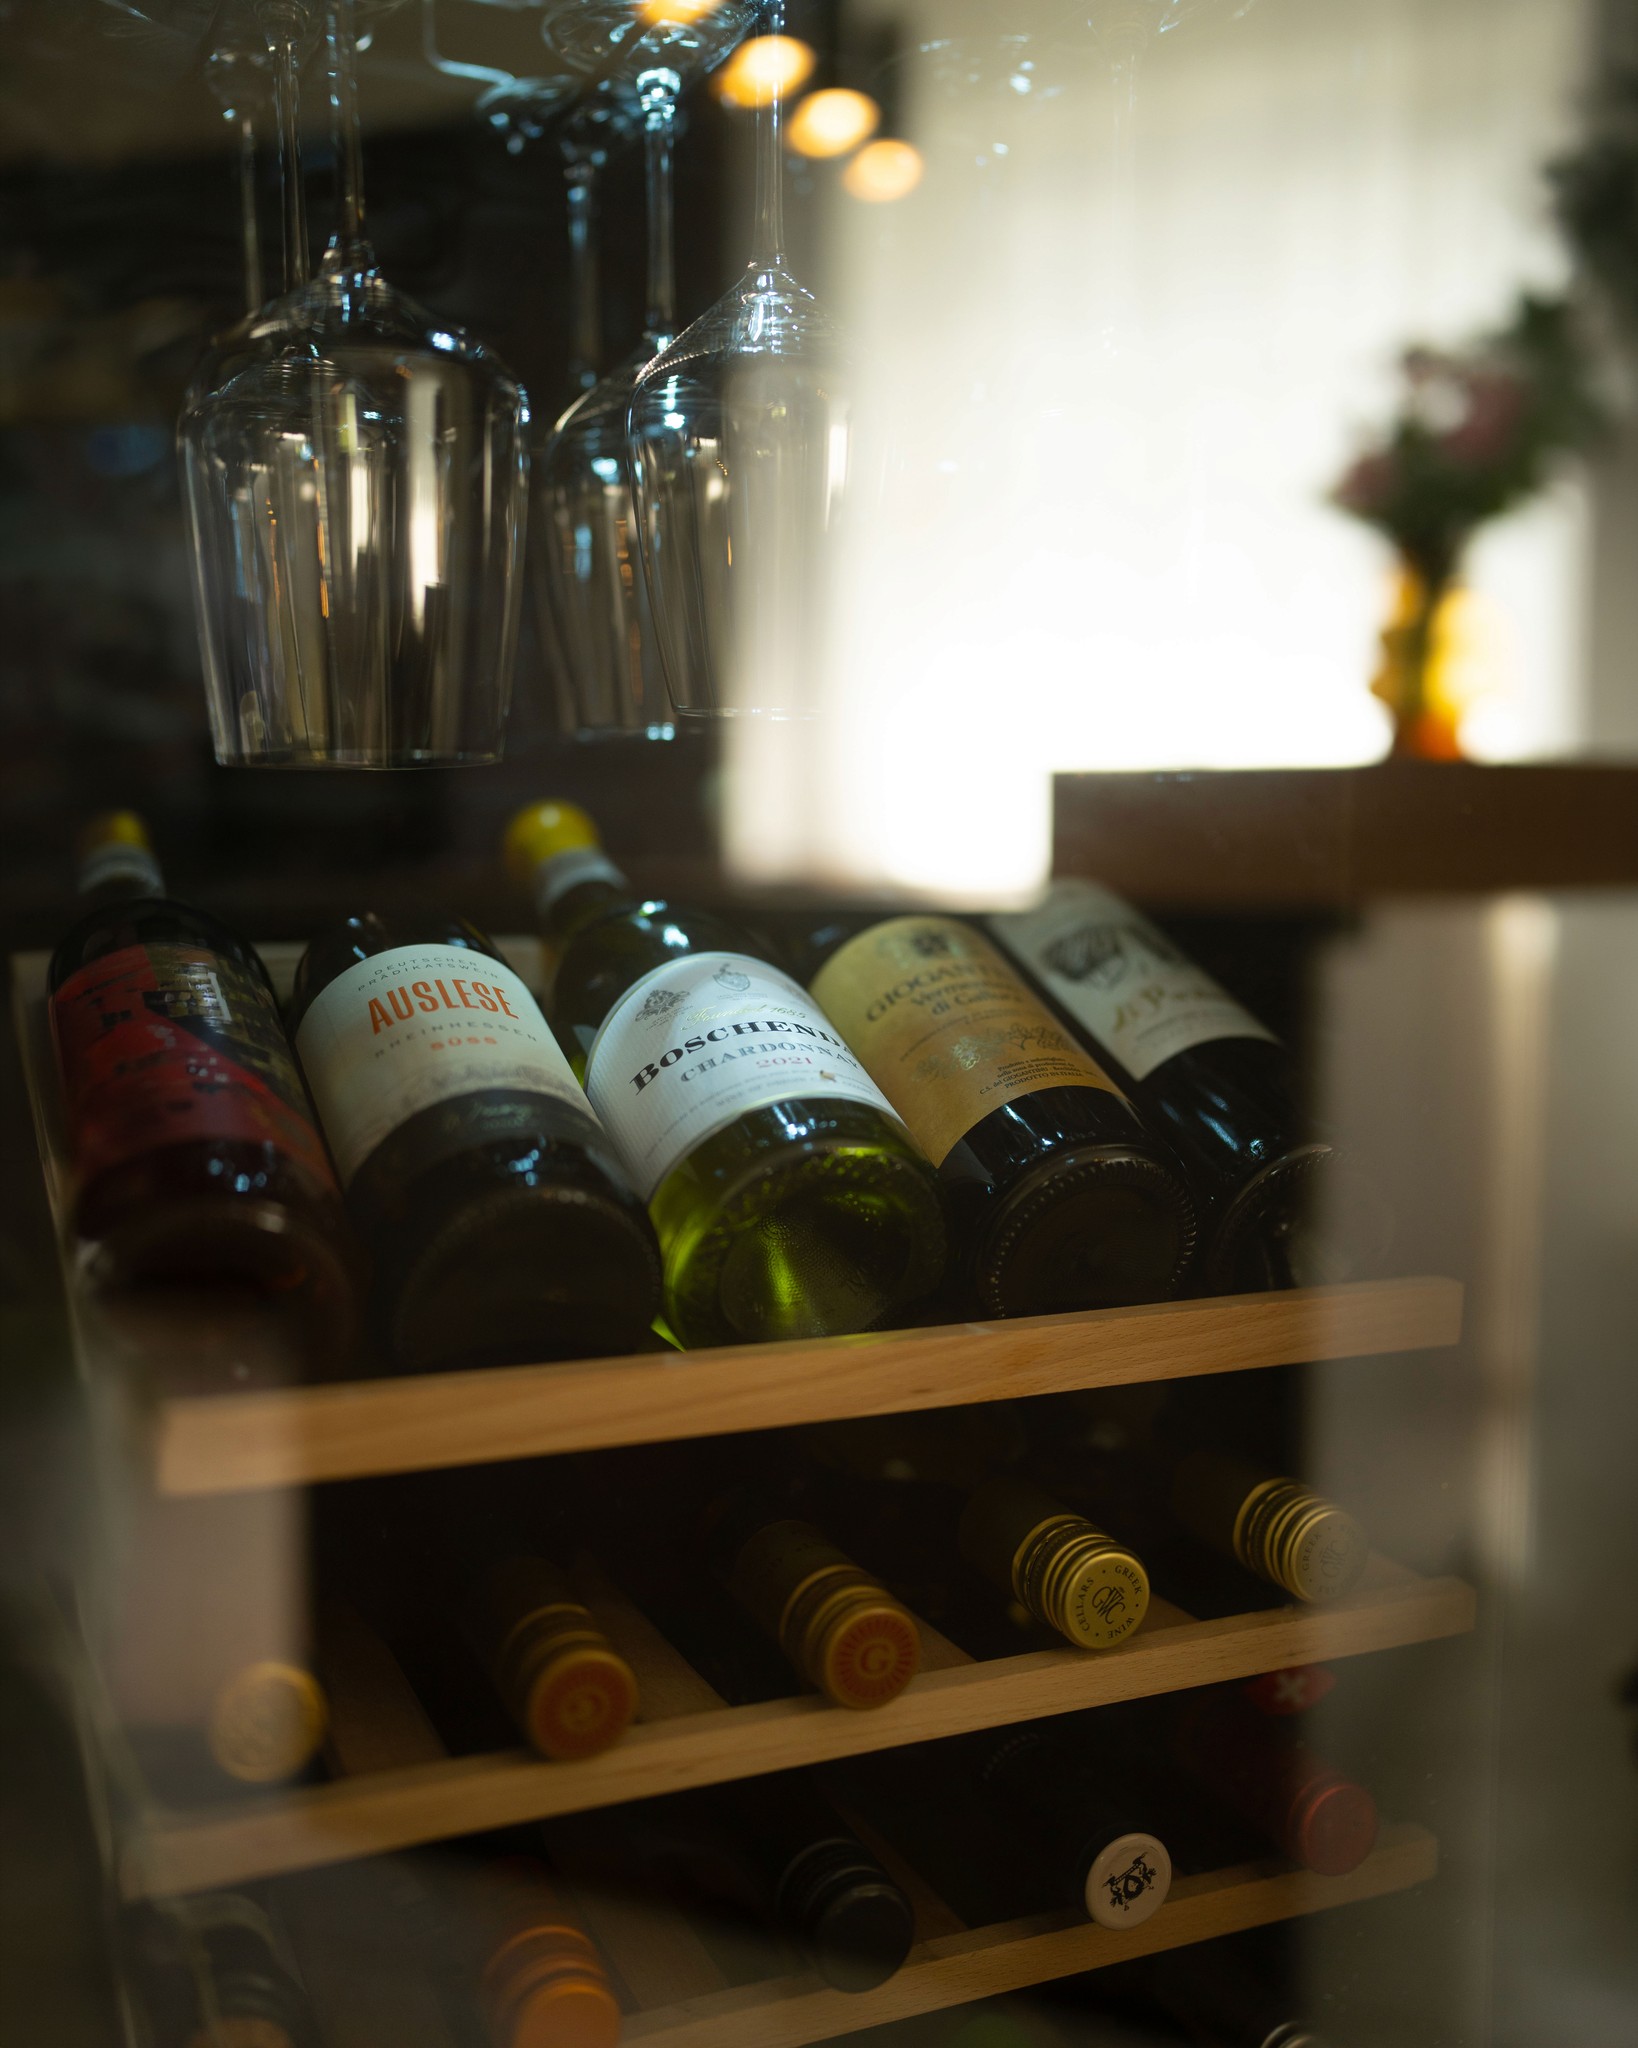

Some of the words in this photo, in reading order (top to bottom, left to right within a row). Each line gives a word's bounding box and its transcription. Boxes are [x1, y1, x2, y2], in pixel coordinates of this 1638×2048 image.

[374, 957, 478, 976] DEUTSCHER
[368, 979, 520, 1036] AUSLESE
[770, 1004, 806, 1019] 1685
[375, 1022, 538, 1059] RHEINHESSEN
[680, 1042, 859, 1082] CHARDONNAY
[756, 1056, 814, 1069] 2021
[993, 1079, 1003, 1088] del
[1005, 1073, 1050, 1088] PRODOTTO
[1115, 1564, 1143, 1595] GREEK
[1075, 1577, 1095, 1632] CELLARS
[1107, 1617, 1136, 1640] WINE
